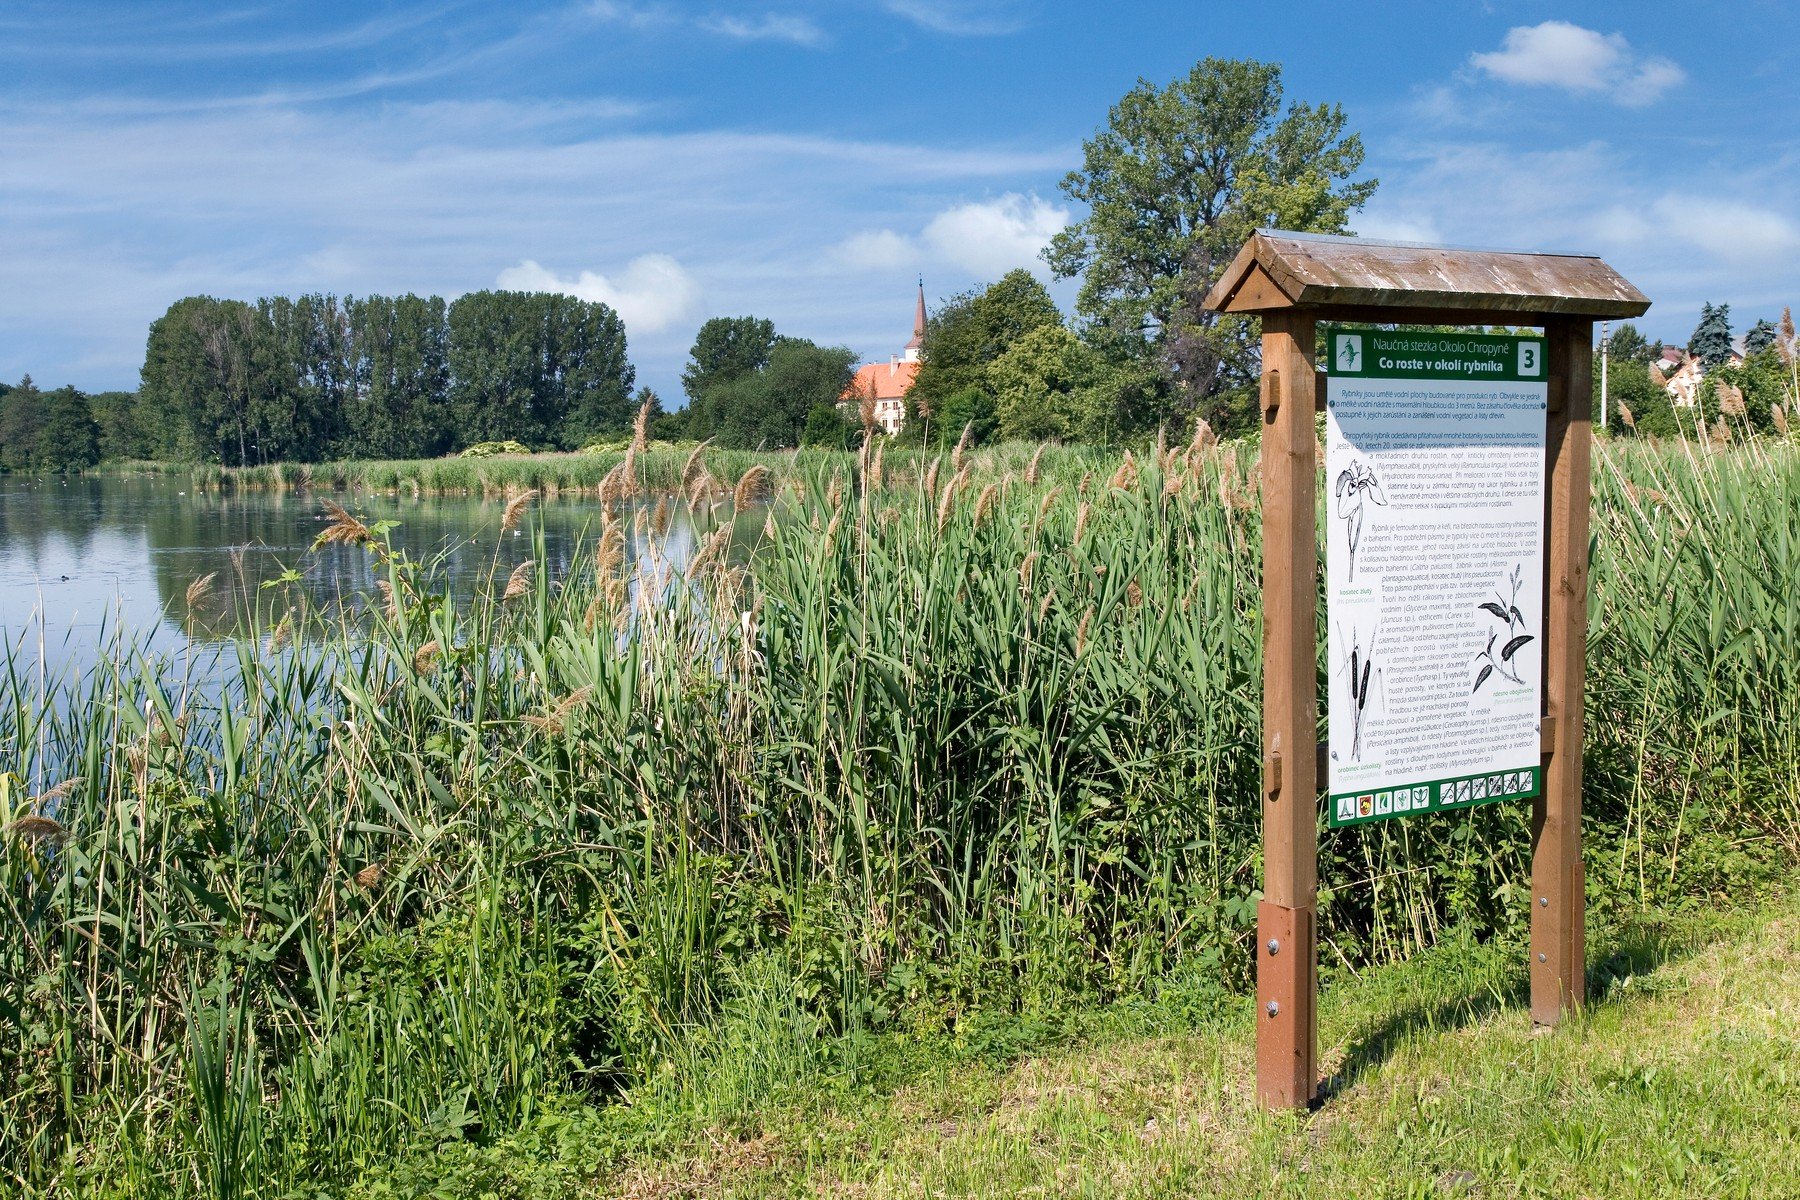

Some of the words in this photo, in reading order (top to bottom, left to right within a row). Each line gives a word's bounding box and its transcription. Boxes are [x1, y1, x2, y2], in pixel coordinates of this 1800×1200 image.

[1373, 338, 1408, 351] Naučná
[1411, 340, 1436, 352] stezka
[1438, 340, 1464, 352] Okolo
[1467, 341, 1509, 357] Chropyně
[1379, 356, 1392, 368] Co
[1396, 358, 1422, 369] roste
[1426, 361, 1432, 369] v
[1434, 358, 1461, 370] okolí
[1463, 358, 1502, 374] rybníka
[1524, 350, 1534, 368] 3
